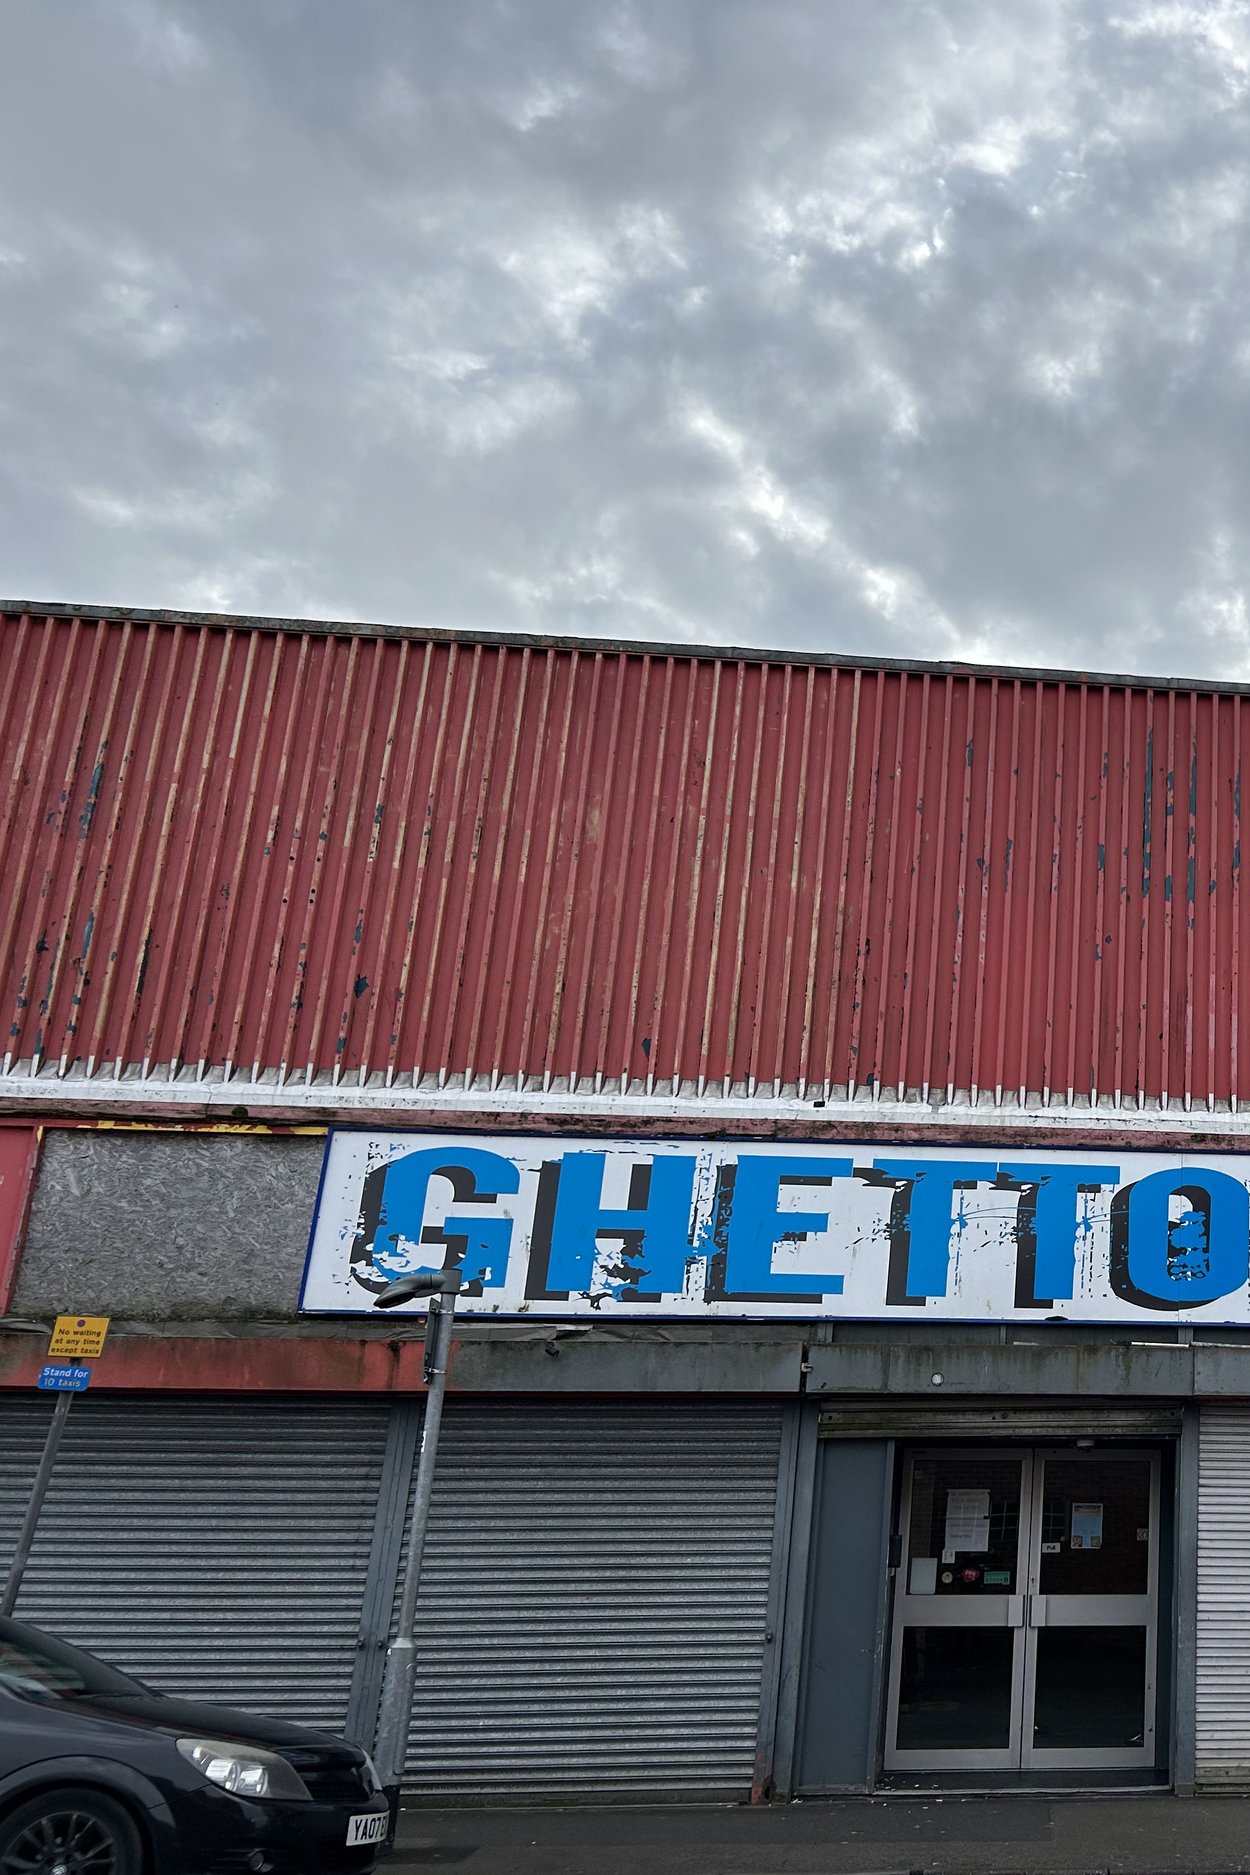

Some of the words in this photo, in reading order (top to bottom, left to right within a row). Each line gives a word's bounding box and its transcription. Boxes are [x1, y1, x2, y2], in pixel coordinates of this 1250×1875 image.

[58, 1328, 70, 1336] No
[73, 1328, 101, 1337] waiting
[83, 1338, 100, 1346] time
[80, 1347, 100, 1355] taxis
[43, 1367, 72, 1378] Stand
[74, 1368, 89, 1379] for
[44, 1378, 55, 1386] 10
[58, 1378, 81, 1387] taxis
